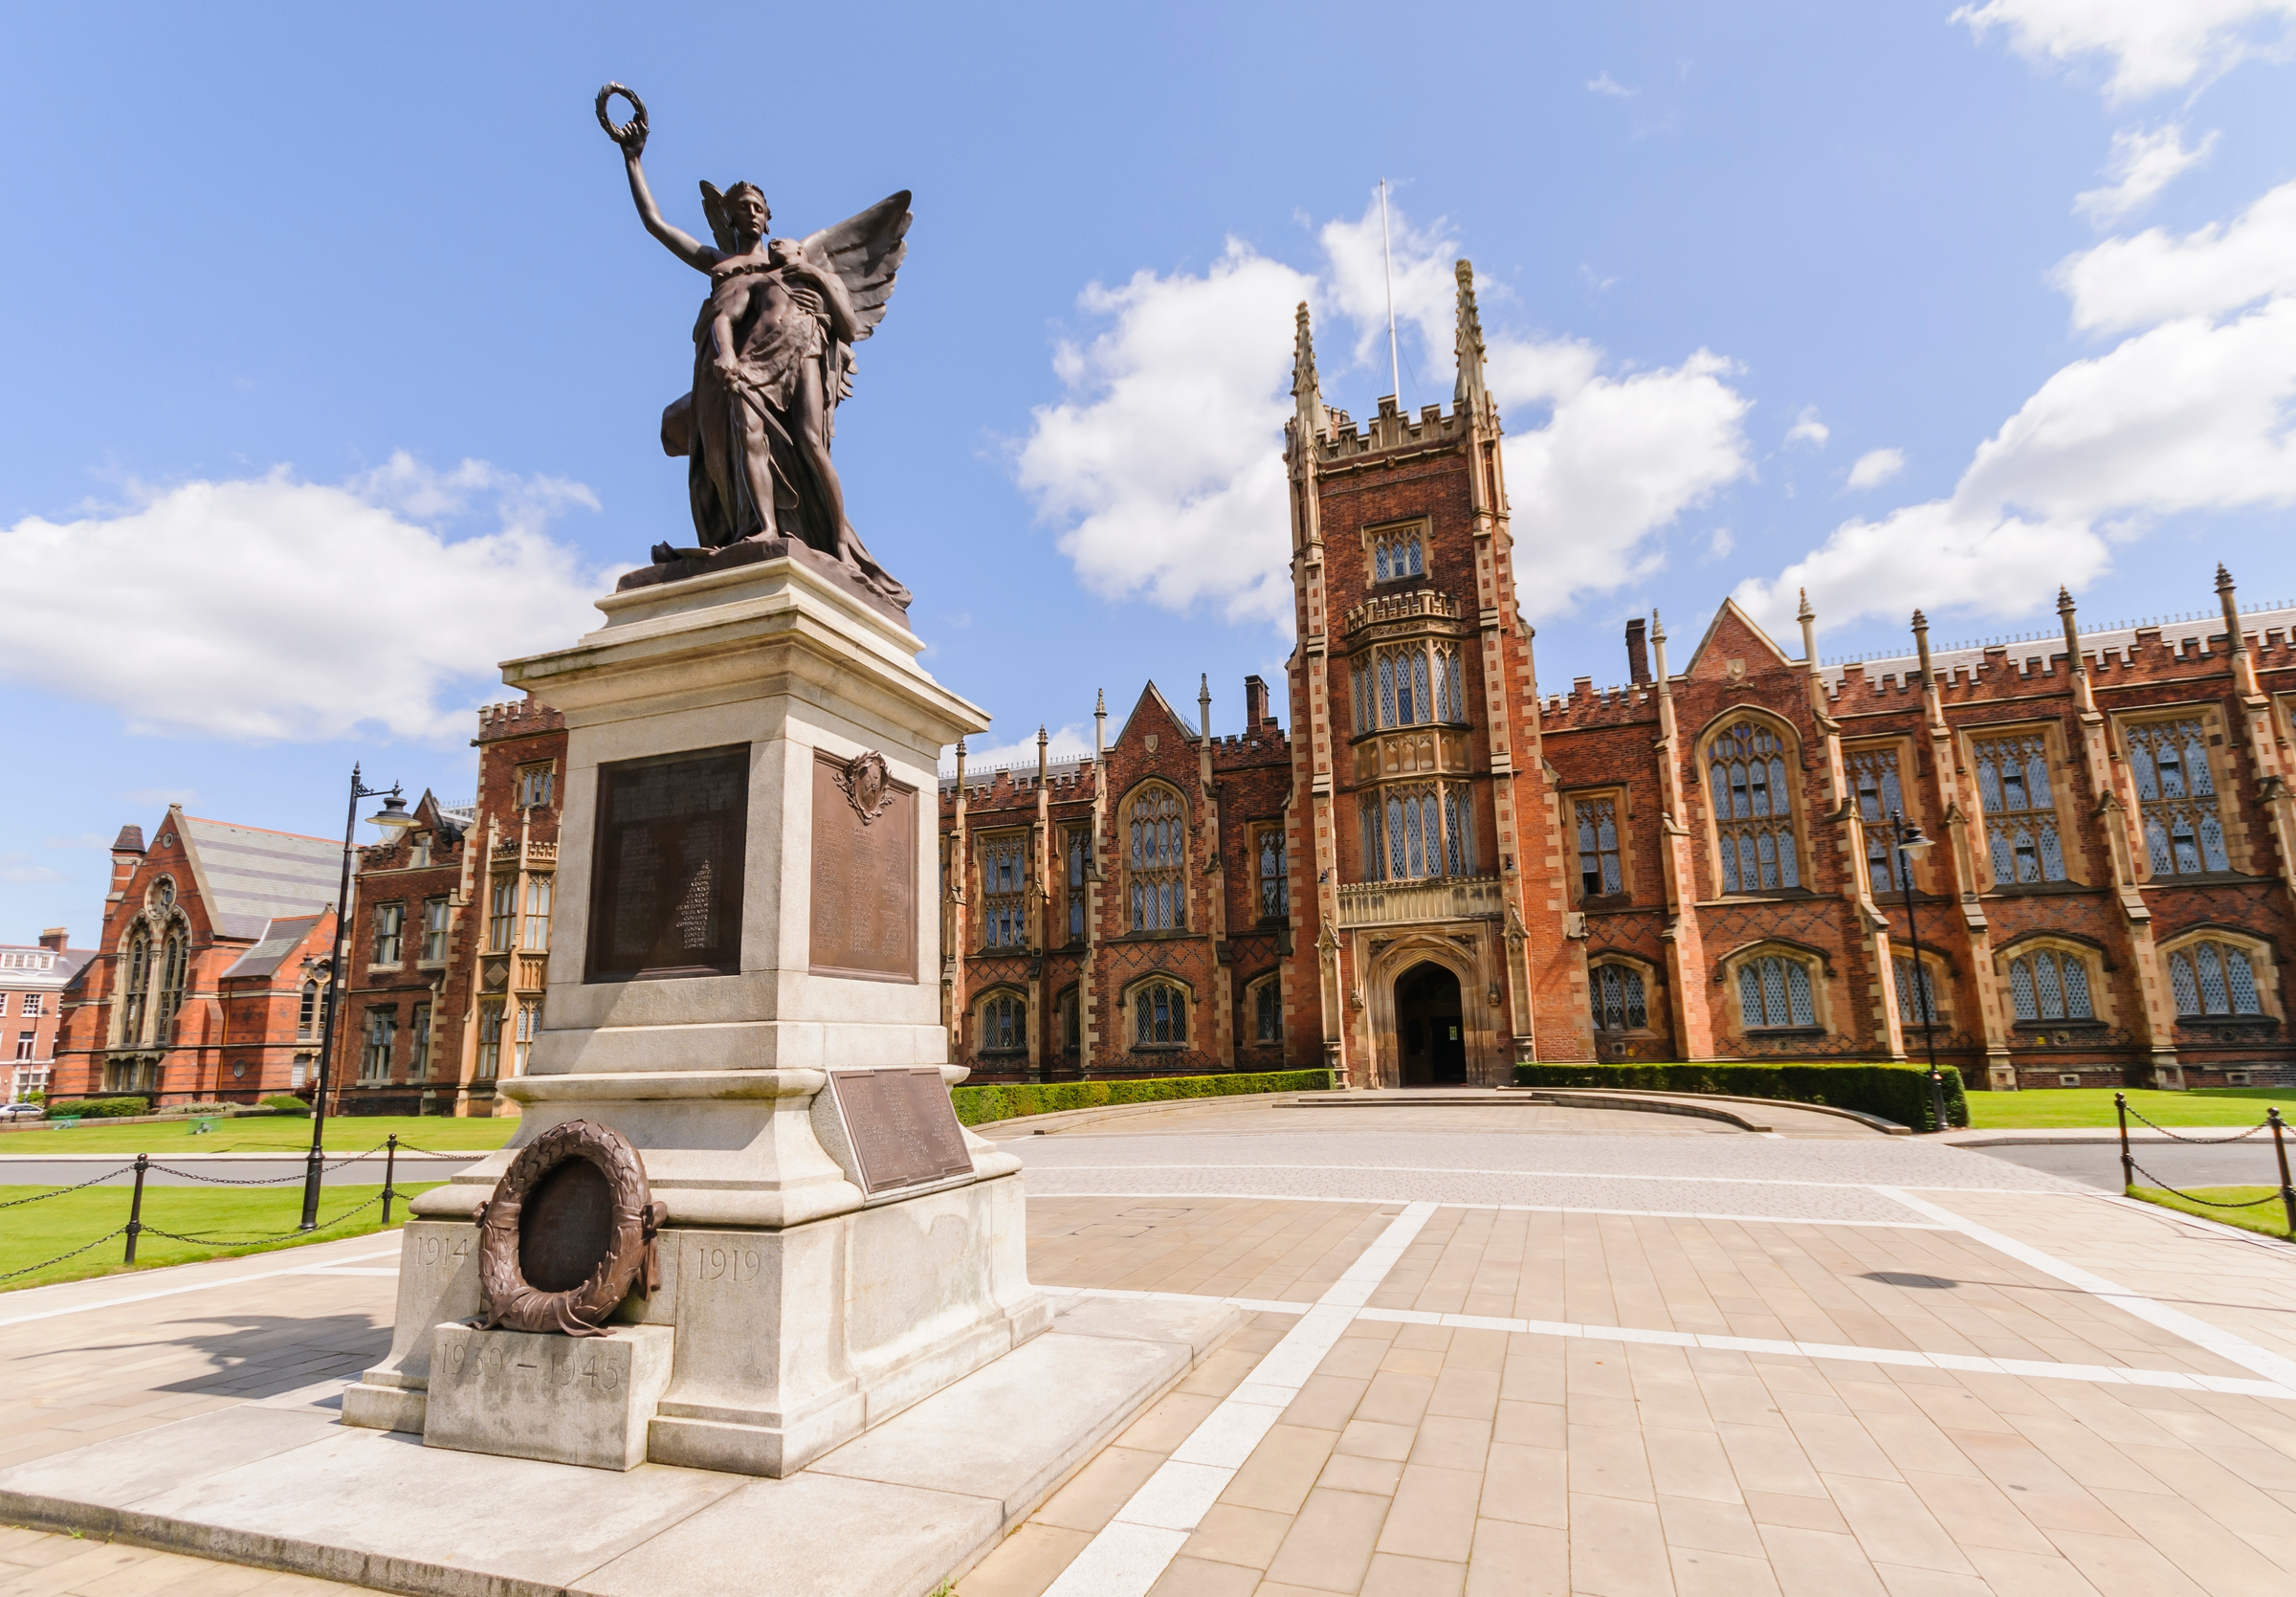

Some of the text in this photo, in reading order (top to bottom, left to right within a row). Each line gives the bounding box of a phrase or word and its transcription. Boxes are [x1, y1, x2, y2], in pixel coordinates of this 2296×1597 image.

[417, 1236, 469, 1267] 1914
[697, 1248, 761, 1282] 1919
[441, 1342, 503, 1380] 1939
[548, 1352, 619, 1390] 1945
